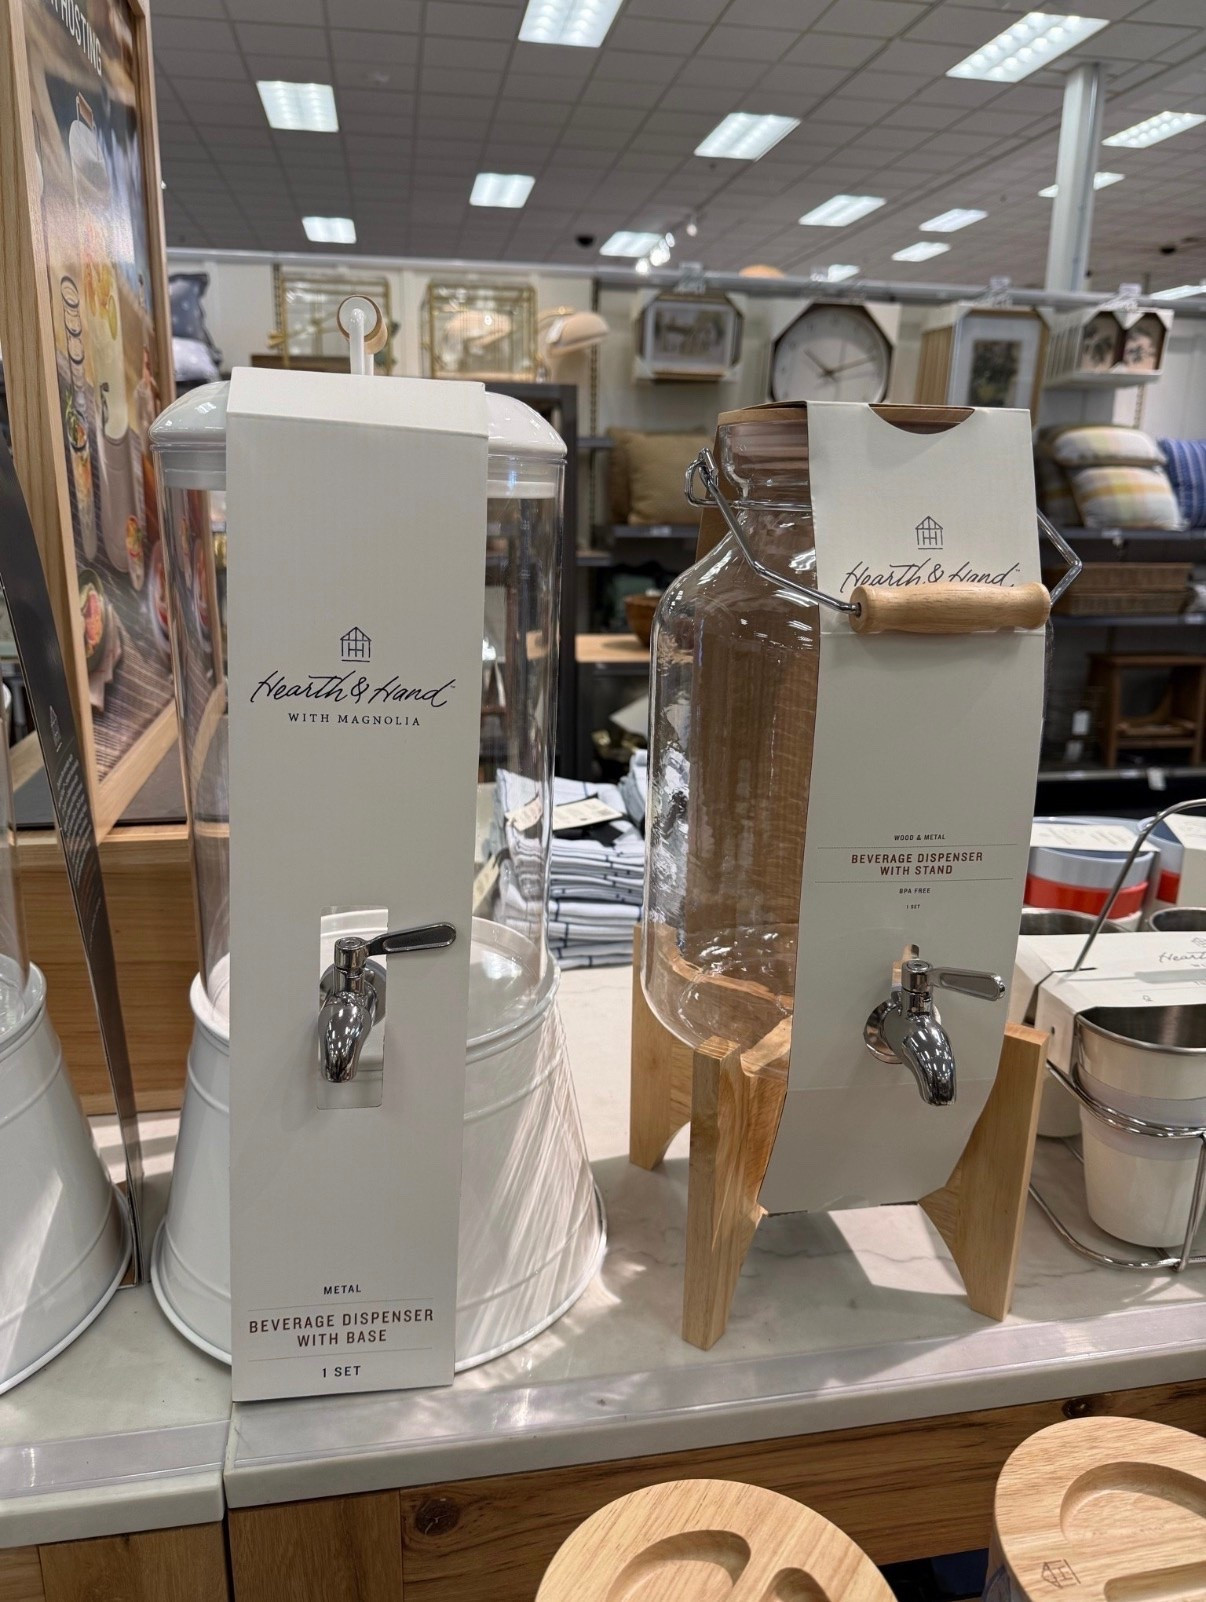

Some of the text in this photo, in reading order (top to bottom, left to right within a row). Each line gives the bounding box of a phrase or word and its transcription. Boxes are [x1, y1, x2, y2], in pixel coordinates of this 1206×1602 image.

[61, 0, 102, 76] HOSTING
[839, 558, 931, 594] Hearth
[927, 563, 945, 583] &
[250, 670, 356, 703] Hearth
[350, 676, 370, 704] &
[288, 712, 420, 726] WITH MAGNOLIA
[893, 833, 914, 841] WOOD
[923, 833, 946, 841] METAL
[851, 852, 983, 864] BEVERAGE DISPENSER
[880, 864, 953, 876] WITH STAND
[898, 887, 912, 895] BPA
[323, 1284, 362, 1295] METAL
[249, 1308, 434, 1333] BEVERAGE DISPENSER
[297, 1329, 387, 1347] WITH BASE
[322, 1365, 361, 1378] 1 SET
